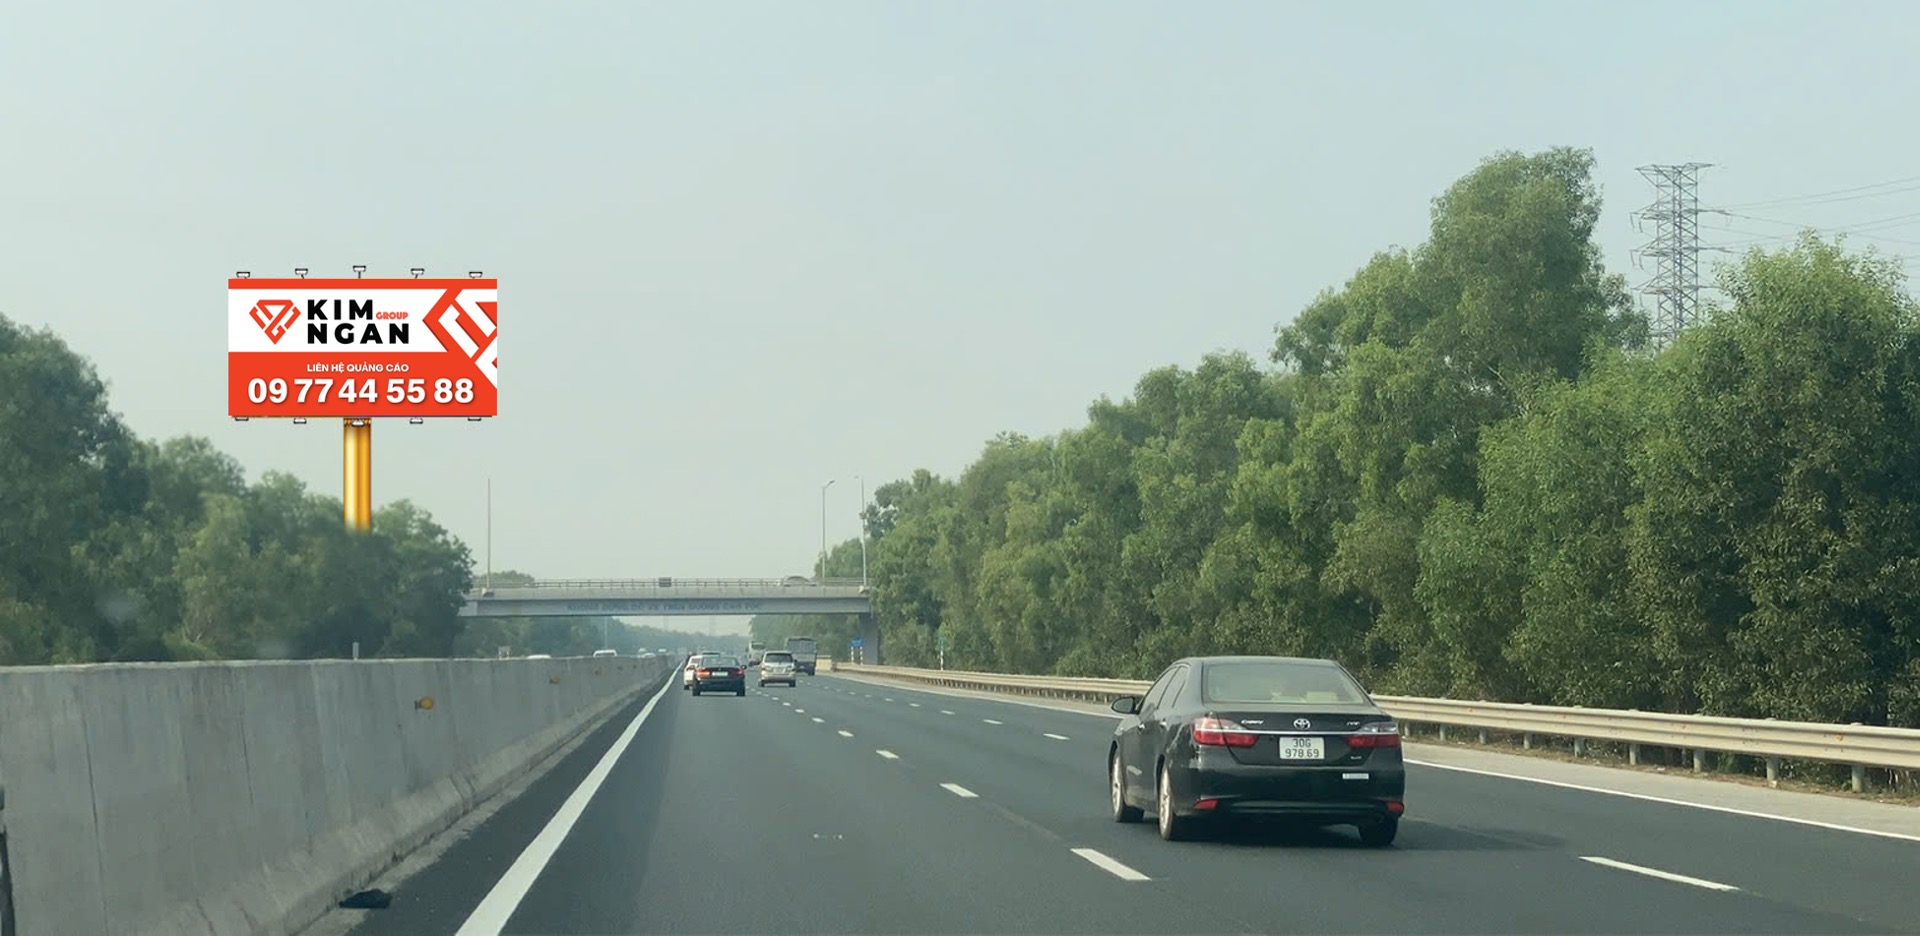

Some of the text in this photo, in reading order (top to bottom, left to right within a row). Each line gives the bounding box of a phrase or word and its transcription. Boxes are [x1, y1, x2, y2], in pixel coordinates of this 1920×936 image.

[307, 299, 409, 320] KIM GROUP
[307, 323, 409, 344] NGAN
[307, 361, 409, 374] LIÊN HỆ QUẢNG CÁO
[248, 377, 474, 403] 09 77 44 55 88
[1292, 738, 1311, 748] 30G
